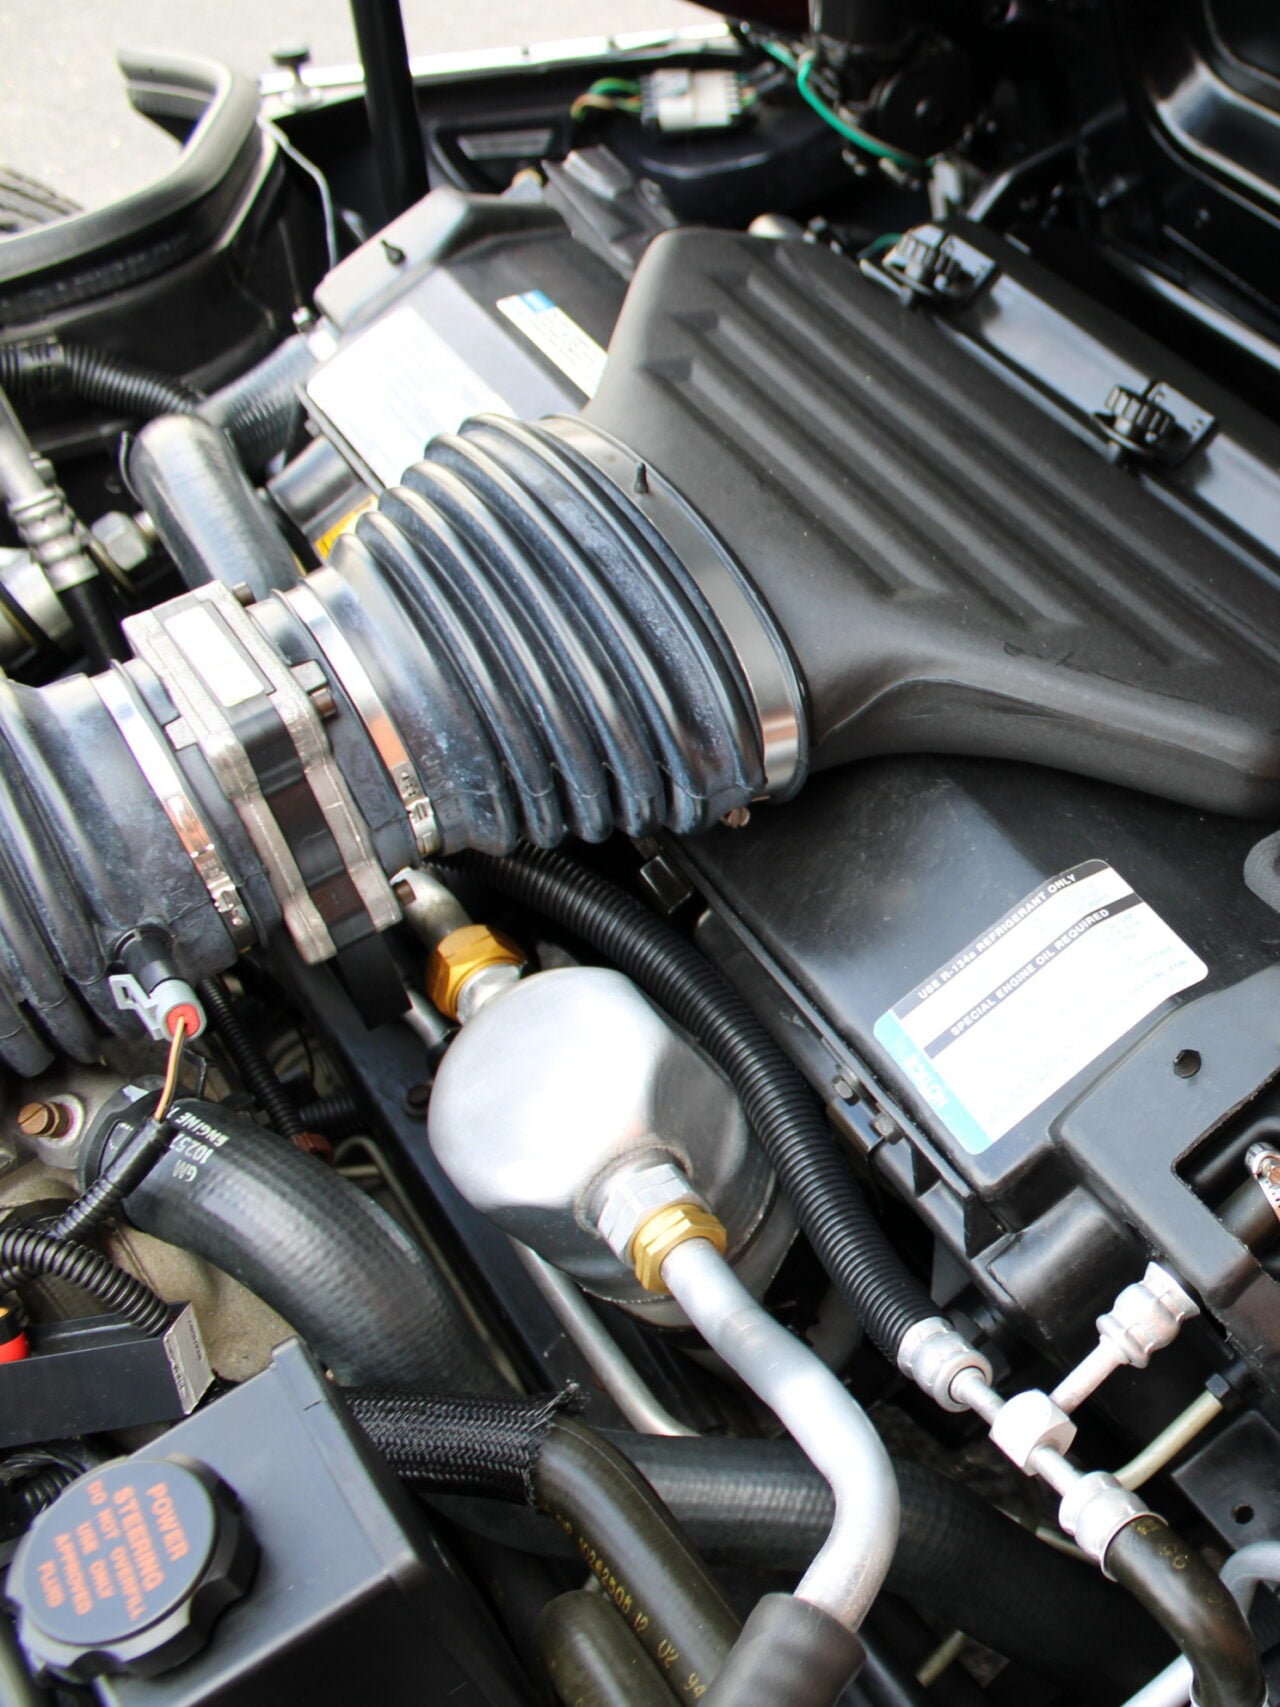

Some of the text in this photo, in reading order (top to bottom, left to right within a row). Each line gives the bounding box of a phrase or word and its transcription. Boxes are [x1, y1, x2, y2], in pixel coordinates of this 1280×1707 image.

[917, 975, 942, 1000] USE
[976, 892, 1047, 953] REFRIGERANT
[1048, 873, 1077, 894] ONLY
[951, 998, 996, 1037] SPECIAL
[996, 962, 1036, 999] ENGINE
[1035, 948, 1056, 967] OIL
[1054, 908, 1110, 951] REQUIRED
[172, 1159, 198, 1182] GM
[175, 1111, 229, 1148] ENGINE
[75, 1521, 116, 1599] USE ONLY
[86, 1479, 147, 1622] DO NOT OVERFILL
[113, 1485, 165, 1592] STEERING
[146, 1482, 191, 1562] POWER
[37, 1560, 65, 1608] FLUID
[53, 1532, 94, 1616] APPROVED
